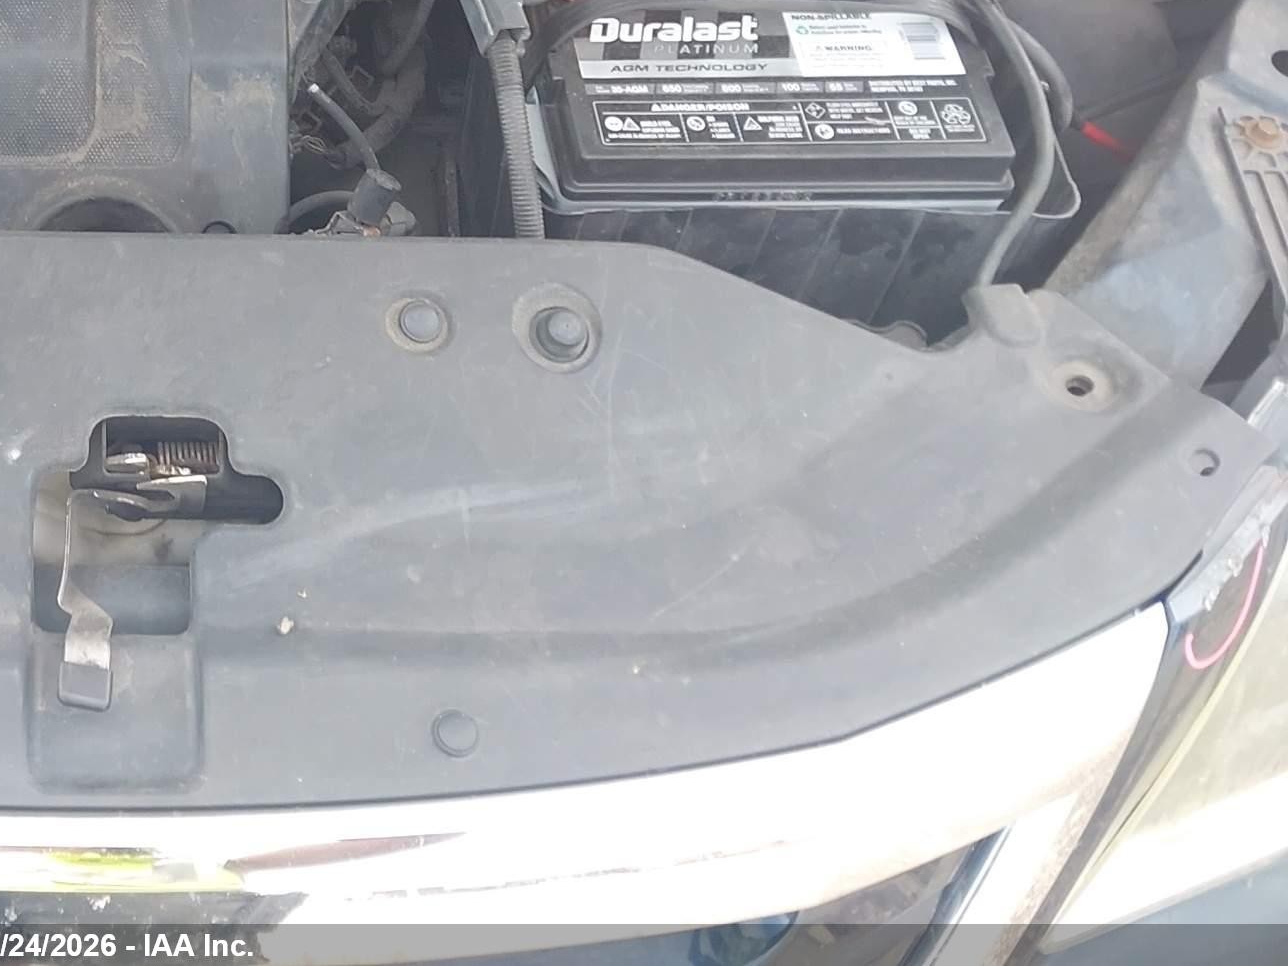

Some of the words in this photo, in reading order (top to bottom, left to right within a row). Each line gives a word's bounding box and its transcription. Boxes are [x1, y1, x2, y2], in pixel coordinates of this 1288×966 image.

[589, 14, 759, 43] Duralast
[654, 43, 759, 54] PLATINUM
[825, 44, 873, 52] WARNING
[610, 65, 649, 73] AGM
[655, 63, 769, 73] TECHNOLOGY
[782, 82, 801, 92] 100
